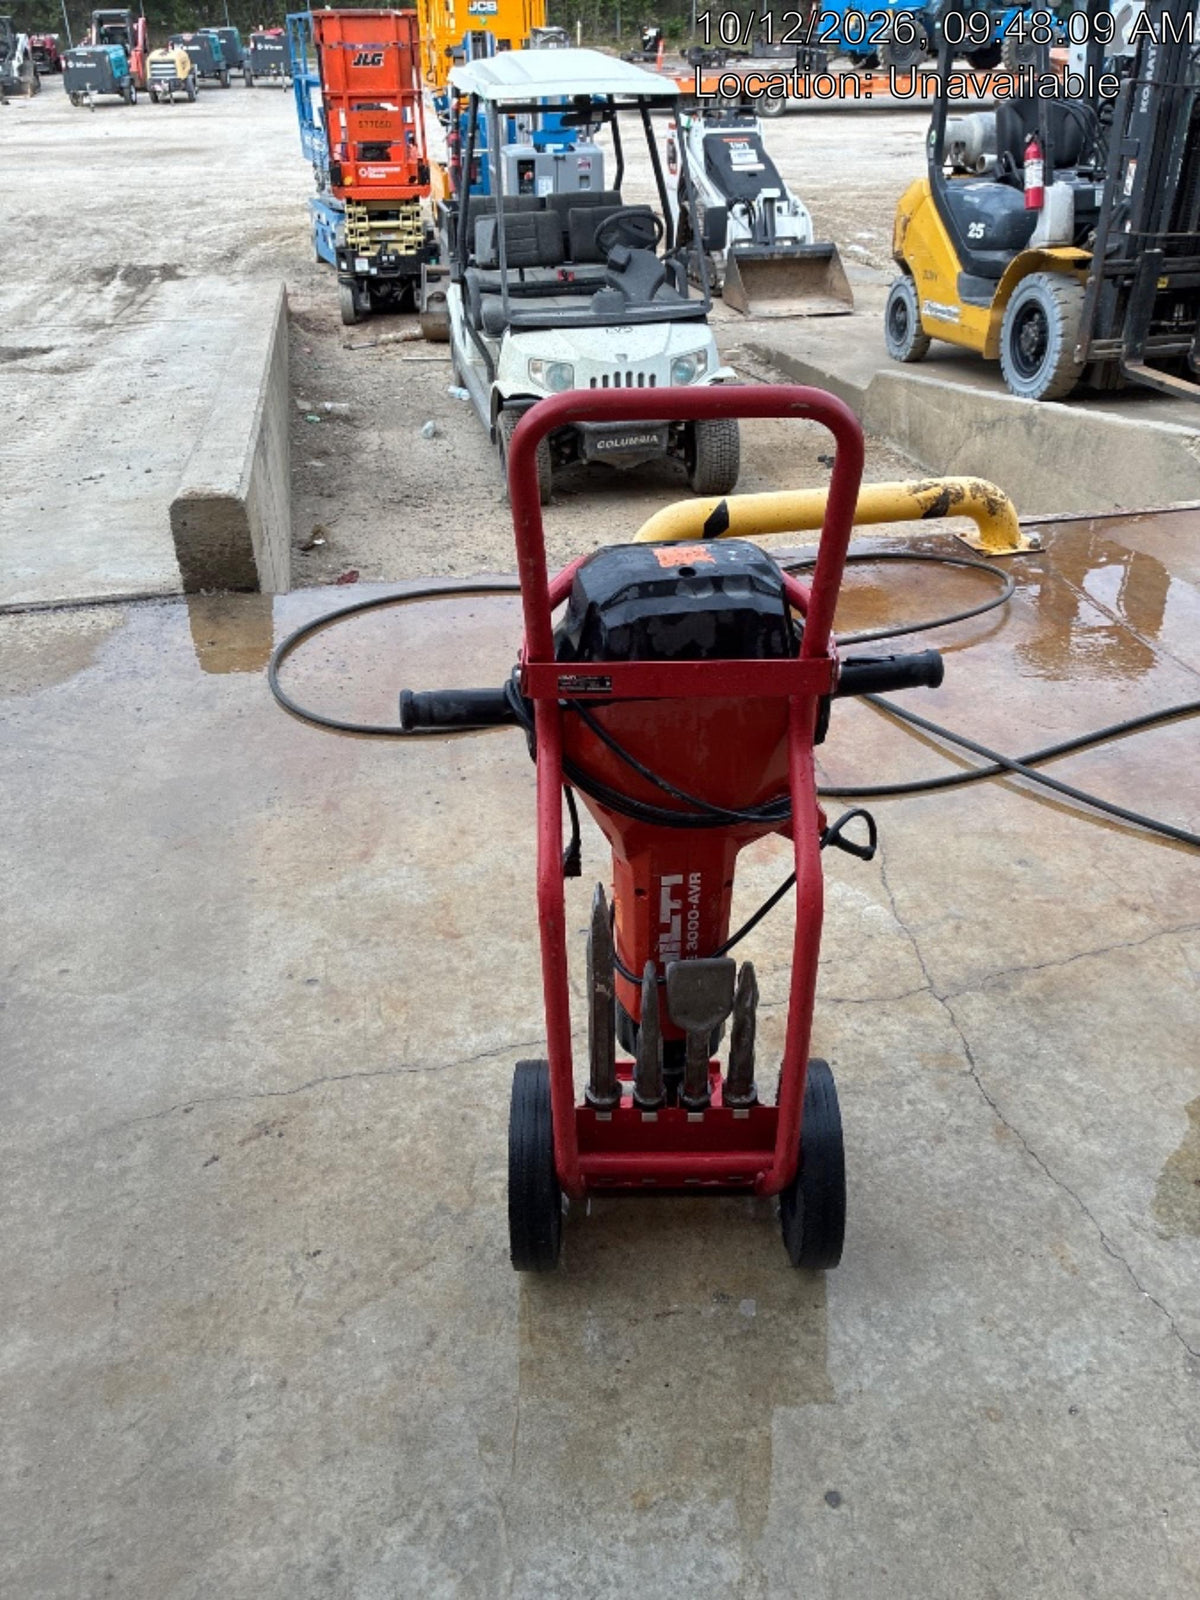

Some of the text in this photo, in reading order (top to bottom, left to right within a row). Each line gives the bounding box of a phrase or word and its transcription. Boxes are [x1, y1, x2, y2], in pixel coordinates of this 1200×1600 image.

[469, 1, 497, 12] JCB
[352, 52, 384, 67] JLG
[967, 221, 986, 239] 25
[596, 434, 659, 449] COLUMBIA
[686, 872, 702, 950] 3000-AVR
